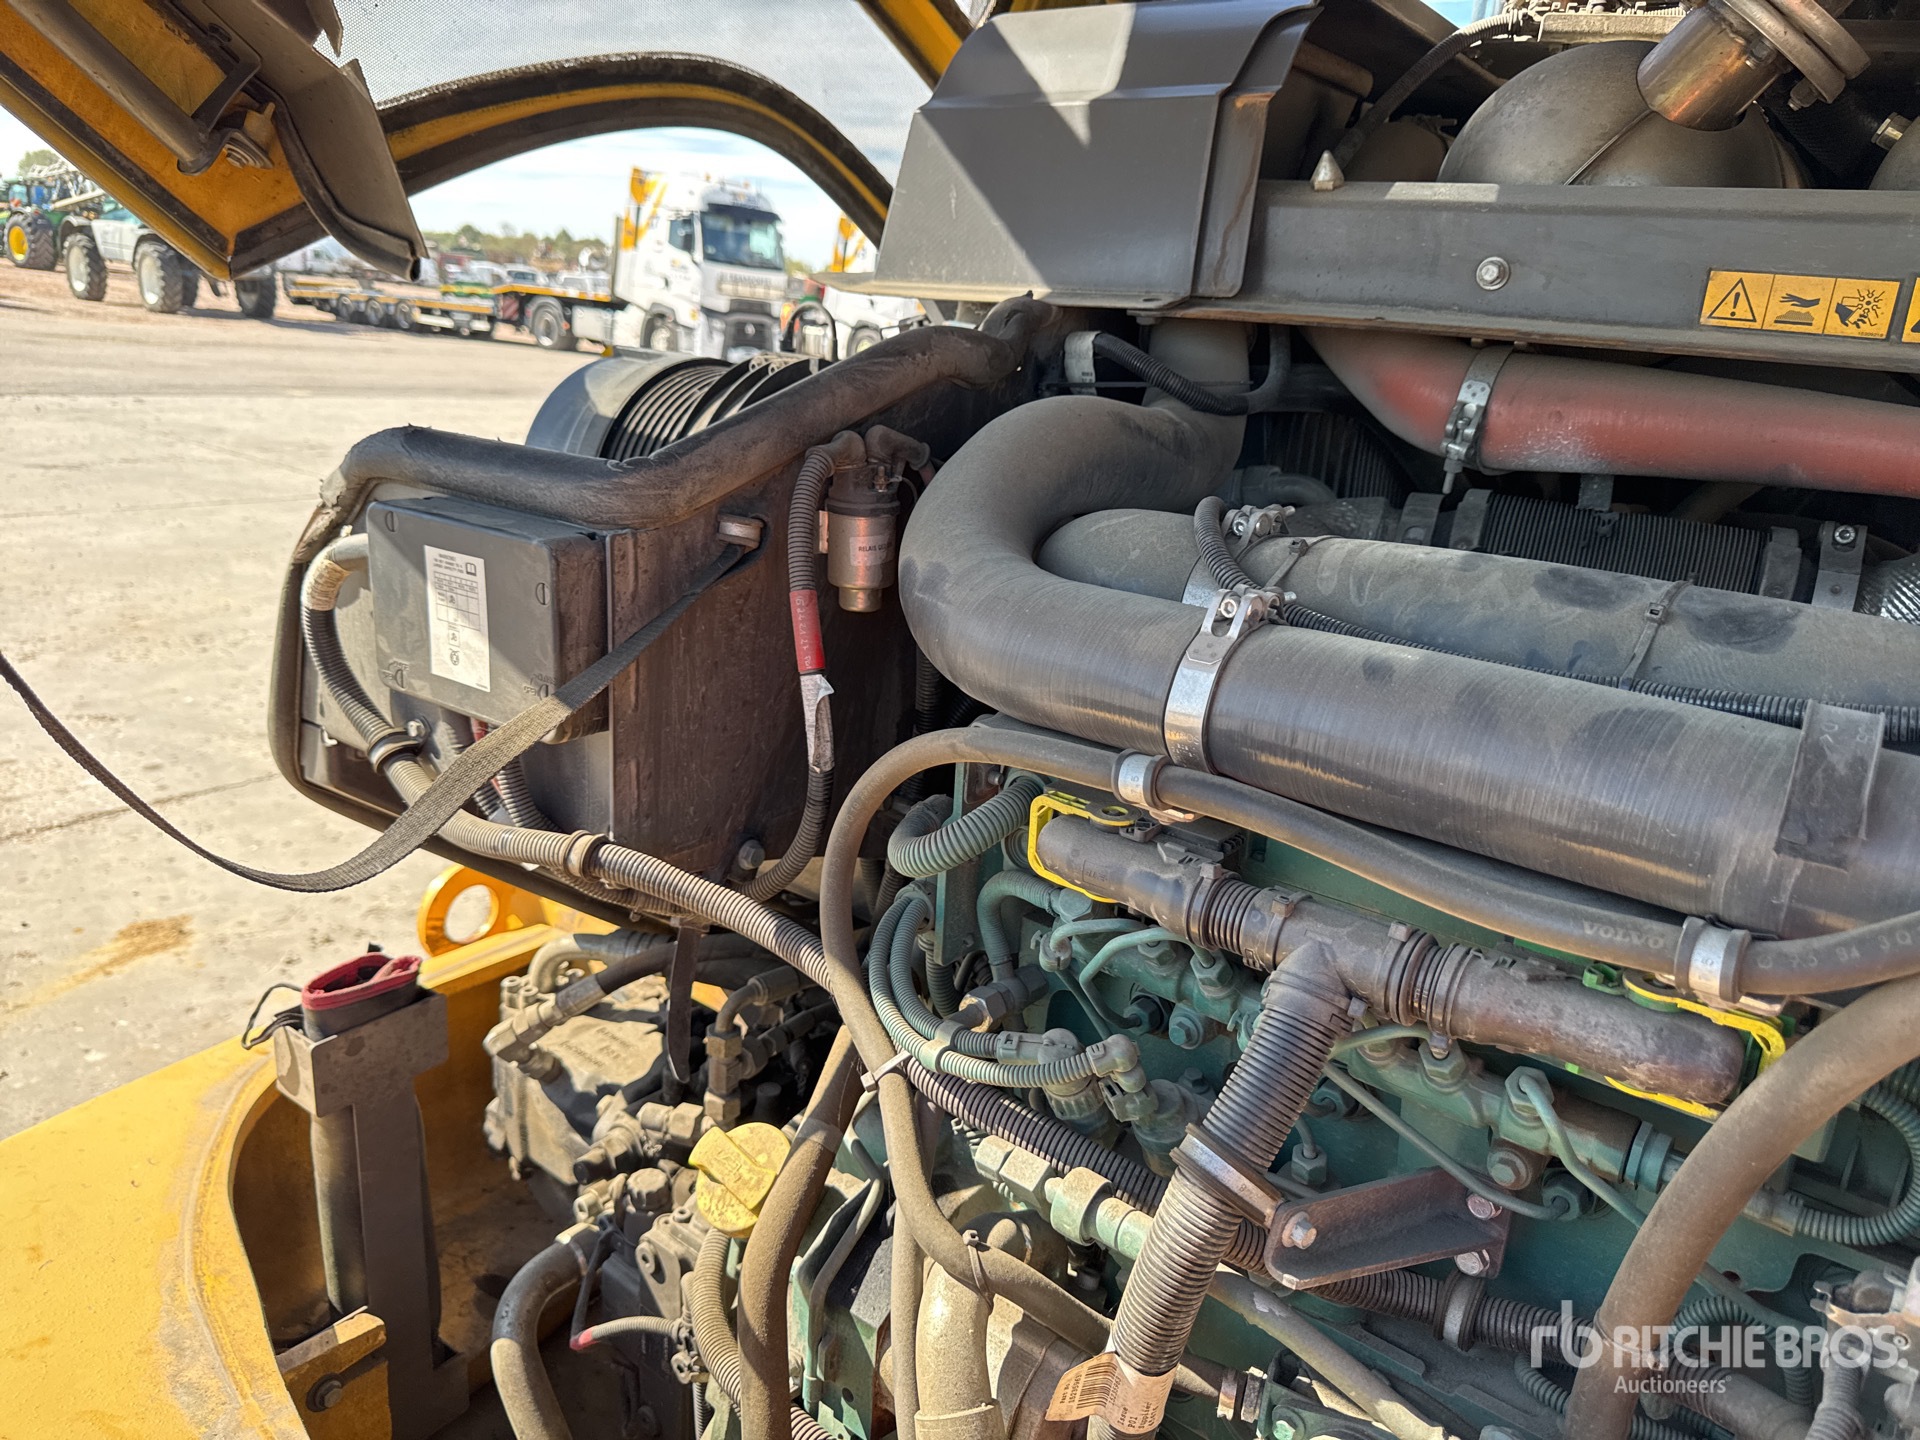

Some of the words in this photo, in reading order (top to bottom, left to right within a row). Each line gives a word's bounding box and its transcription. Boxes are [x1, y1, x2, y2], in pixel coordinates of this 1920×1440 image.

[1582, 920, 1665, 949] VOLVO
[1068, 1375, 1082, 1403] 15235963
[1117, 1407, 1129, 1425] Issue
[1127, 1417, 1138, 1428] P01
[1138, 1402, 1152, 1428] Supplier
